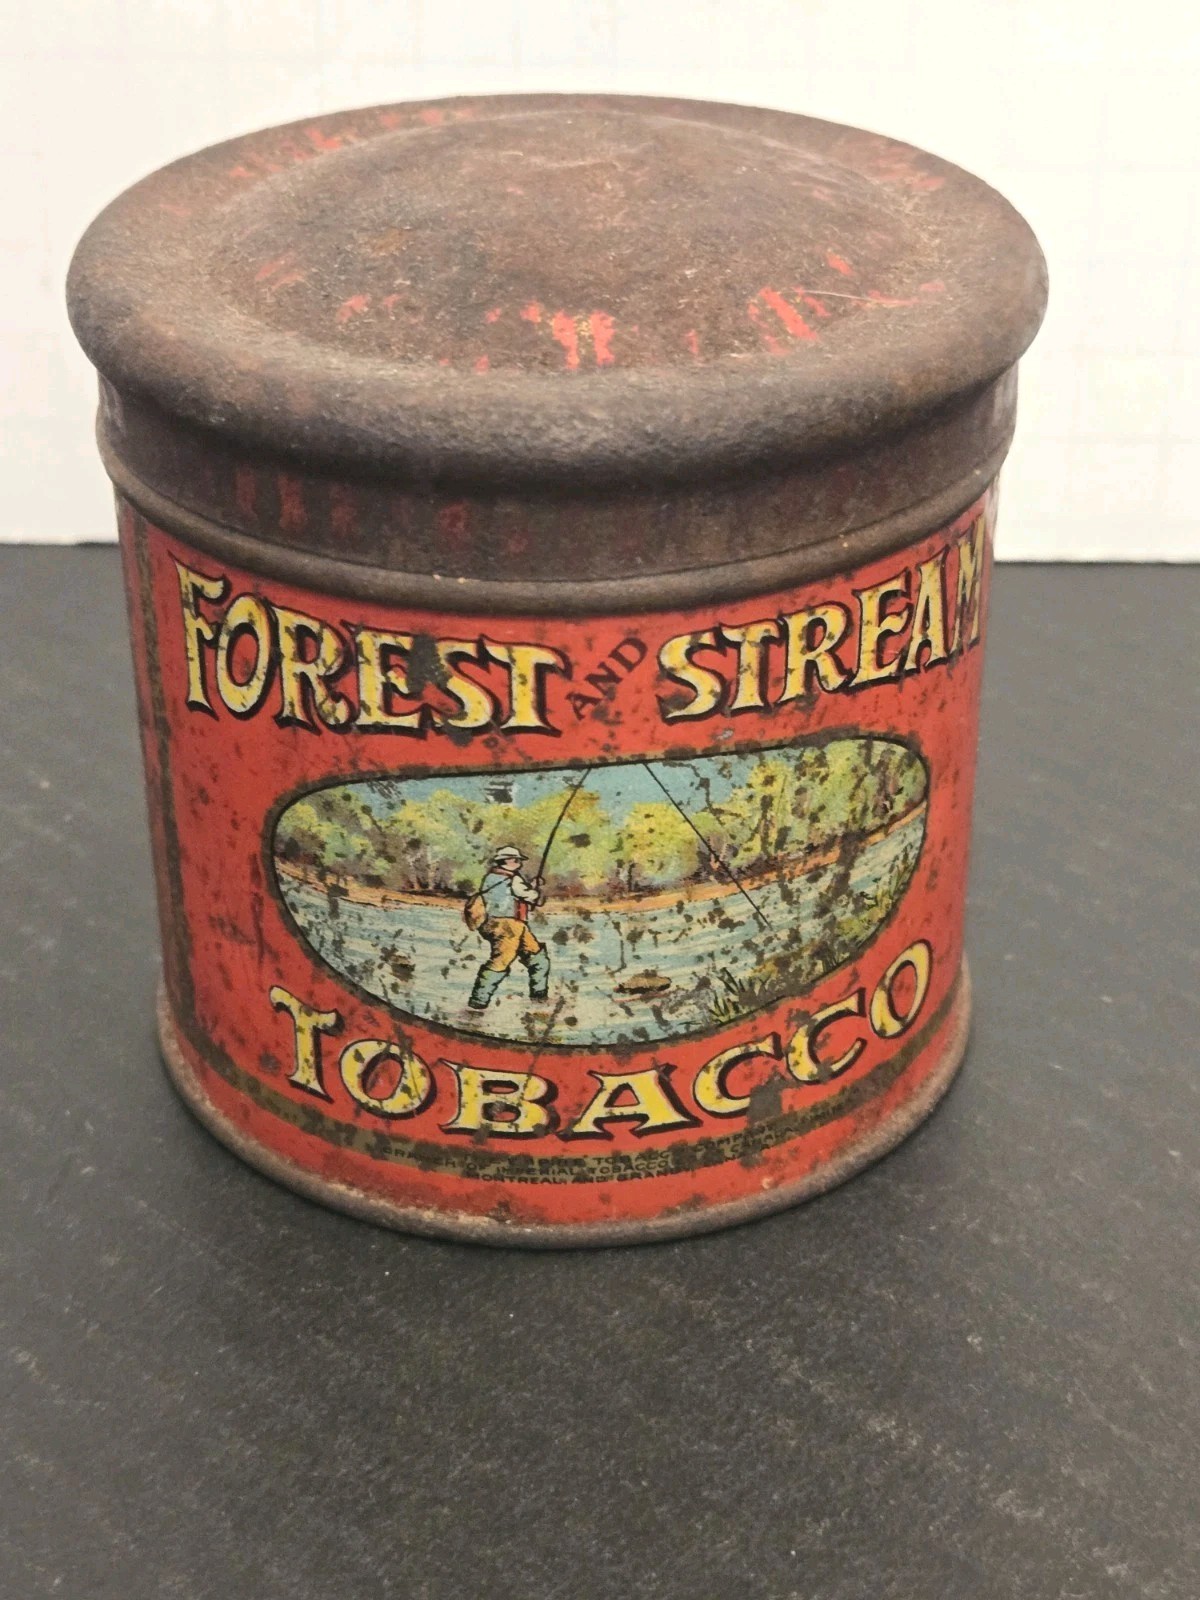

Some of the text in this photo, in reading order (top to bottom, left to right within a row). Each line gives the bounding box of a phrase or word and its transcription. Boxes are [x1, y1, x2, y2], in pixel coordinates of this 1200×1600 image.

[168, 514, 986, 740] FOREST AND STREAM
[269, 940, 934, 1141] TOBACCO
